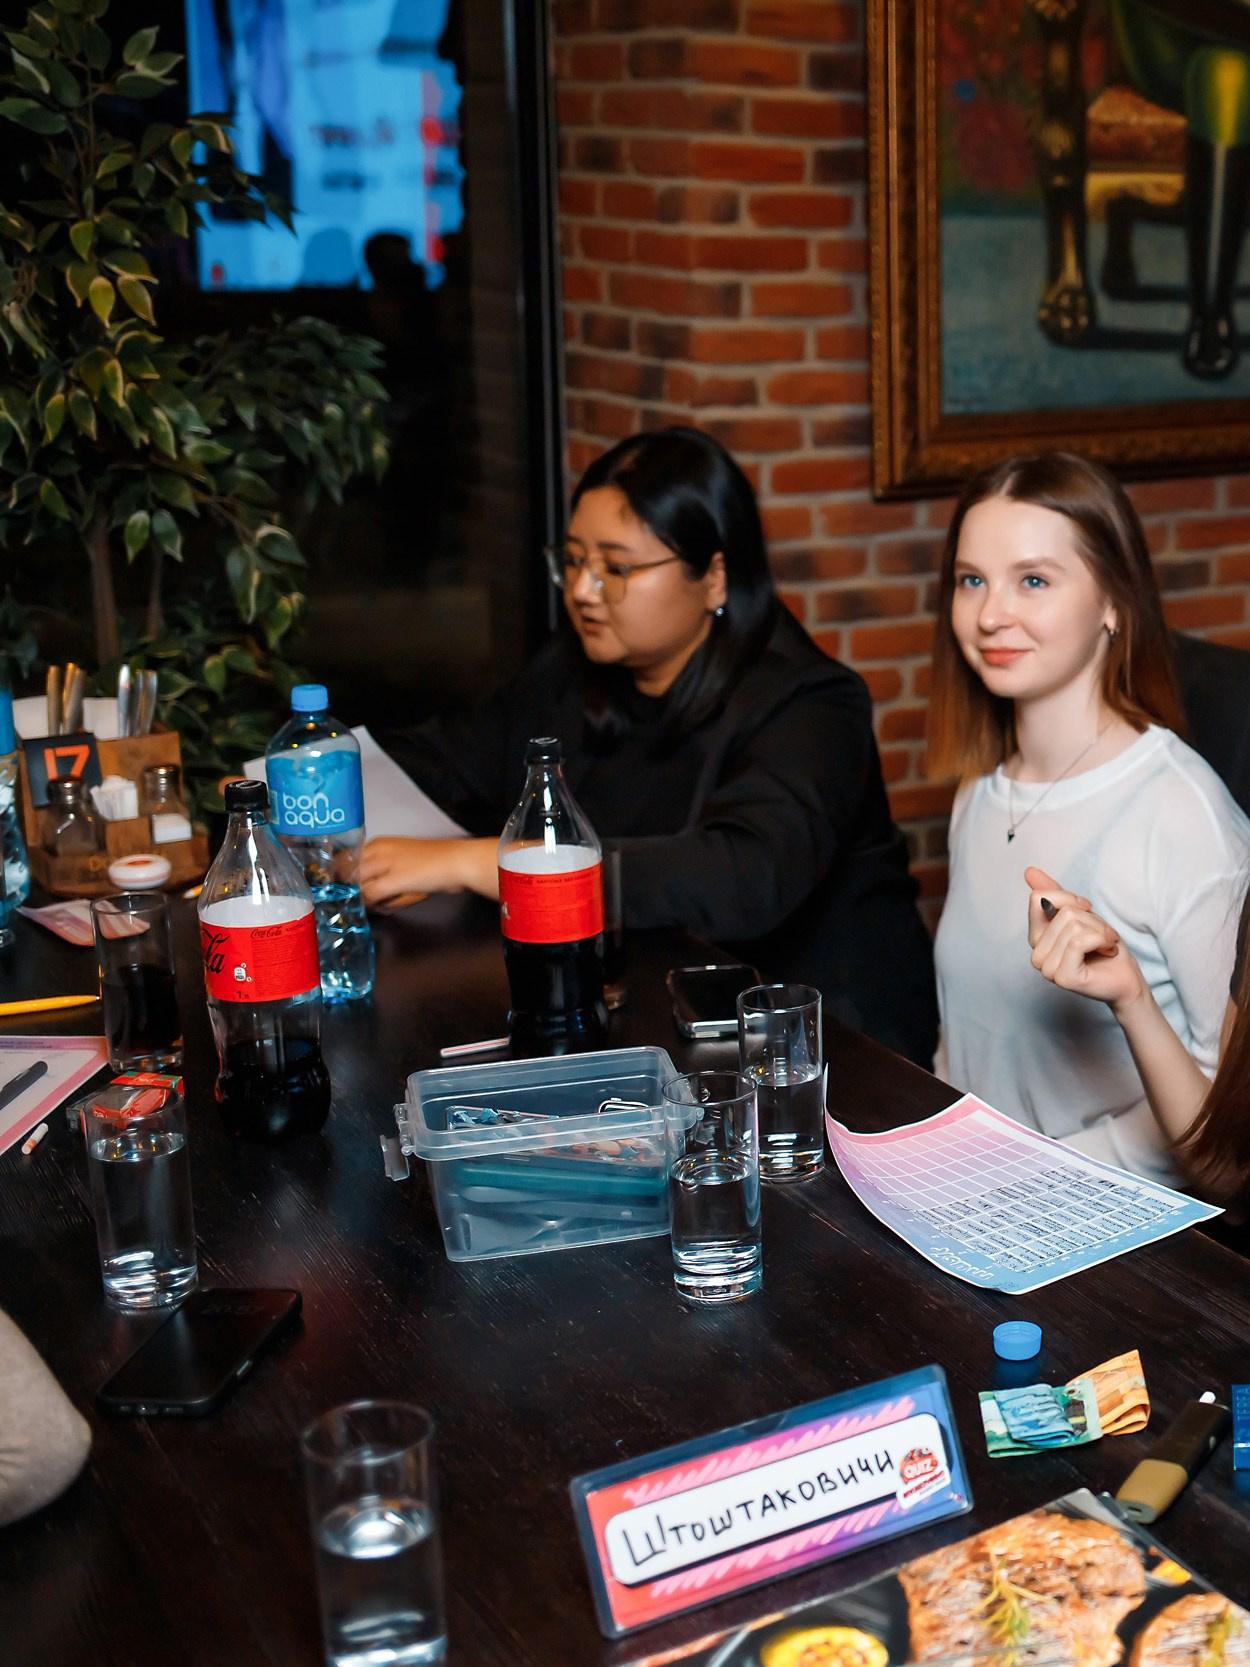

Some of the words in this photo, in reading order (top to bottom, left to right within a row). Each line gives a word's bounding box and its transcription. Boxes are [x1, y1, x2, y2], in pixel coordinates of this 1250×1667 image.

[43, 744, 91, 780] 17
[282, 791, 329, 810] bon
[284, 808, 345, 829] aqua
[903, 1458, 935, 1479] QUIZ
